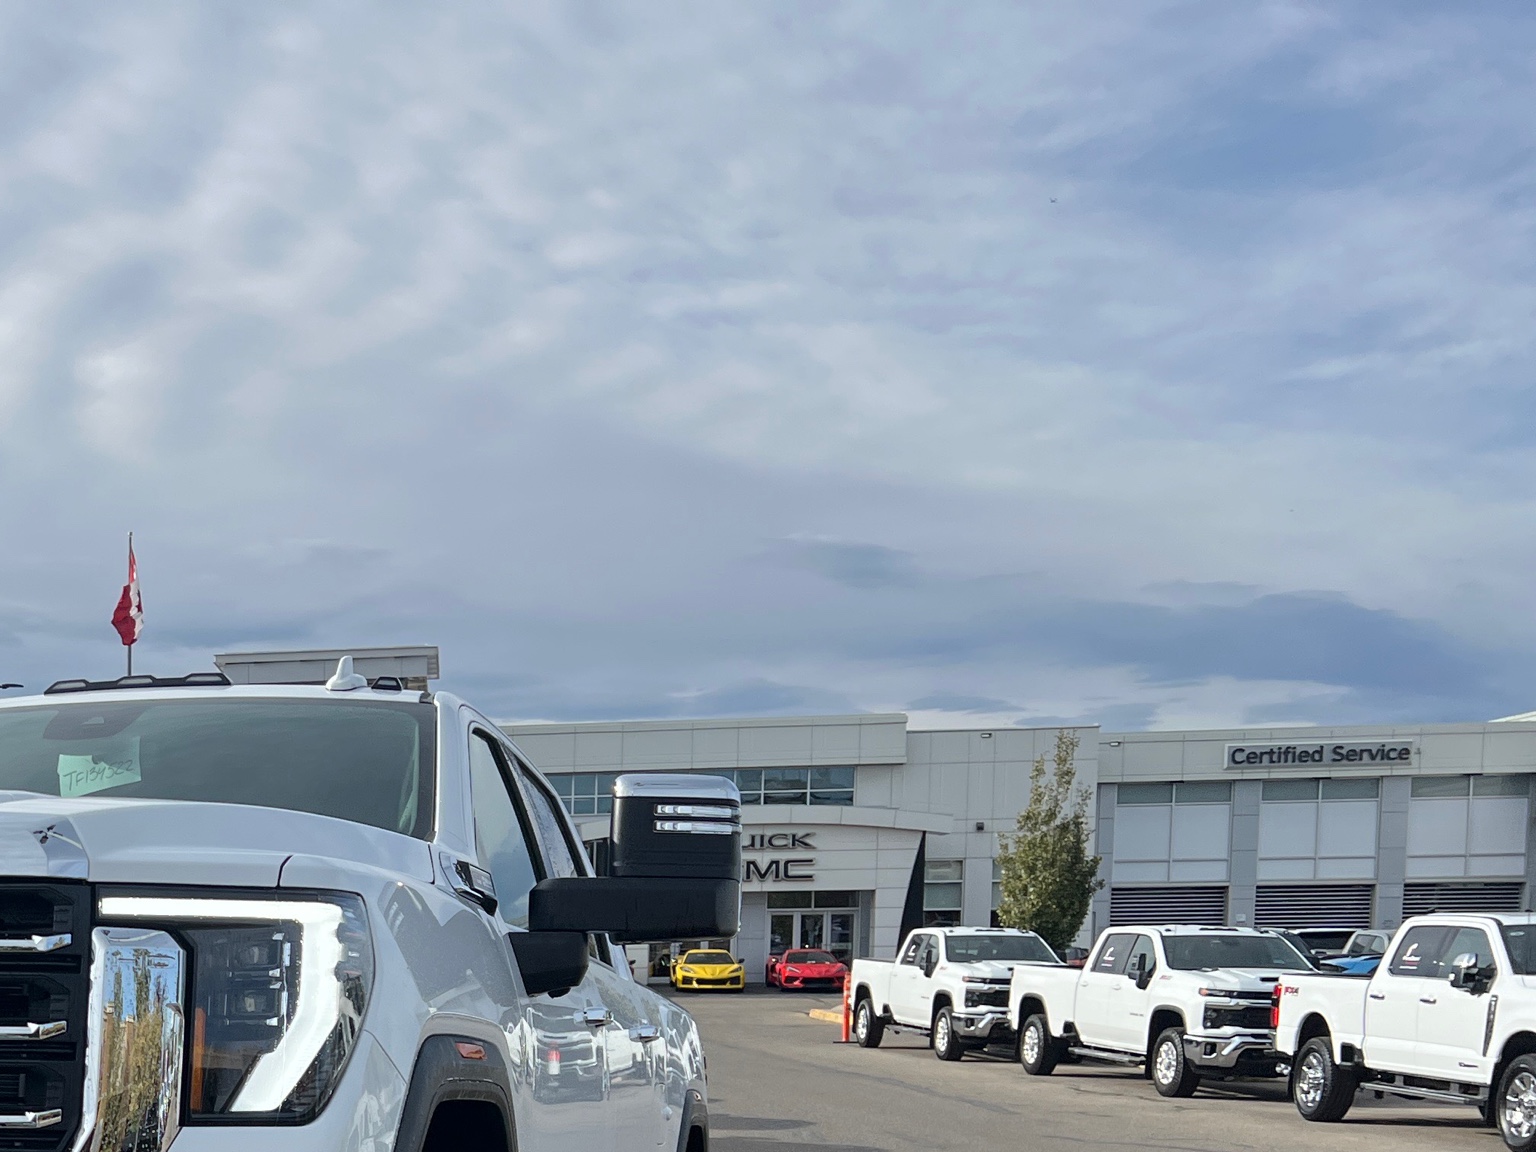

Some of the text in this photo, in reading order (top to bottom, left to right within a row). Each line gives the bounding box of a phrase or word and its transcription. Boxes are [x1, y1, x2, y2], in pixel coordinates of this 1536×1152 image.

[1231, 744, 1411, 765] Certified Service
[742, 832, 817, 850] UICK
[742, 858, 815, 882] MC
